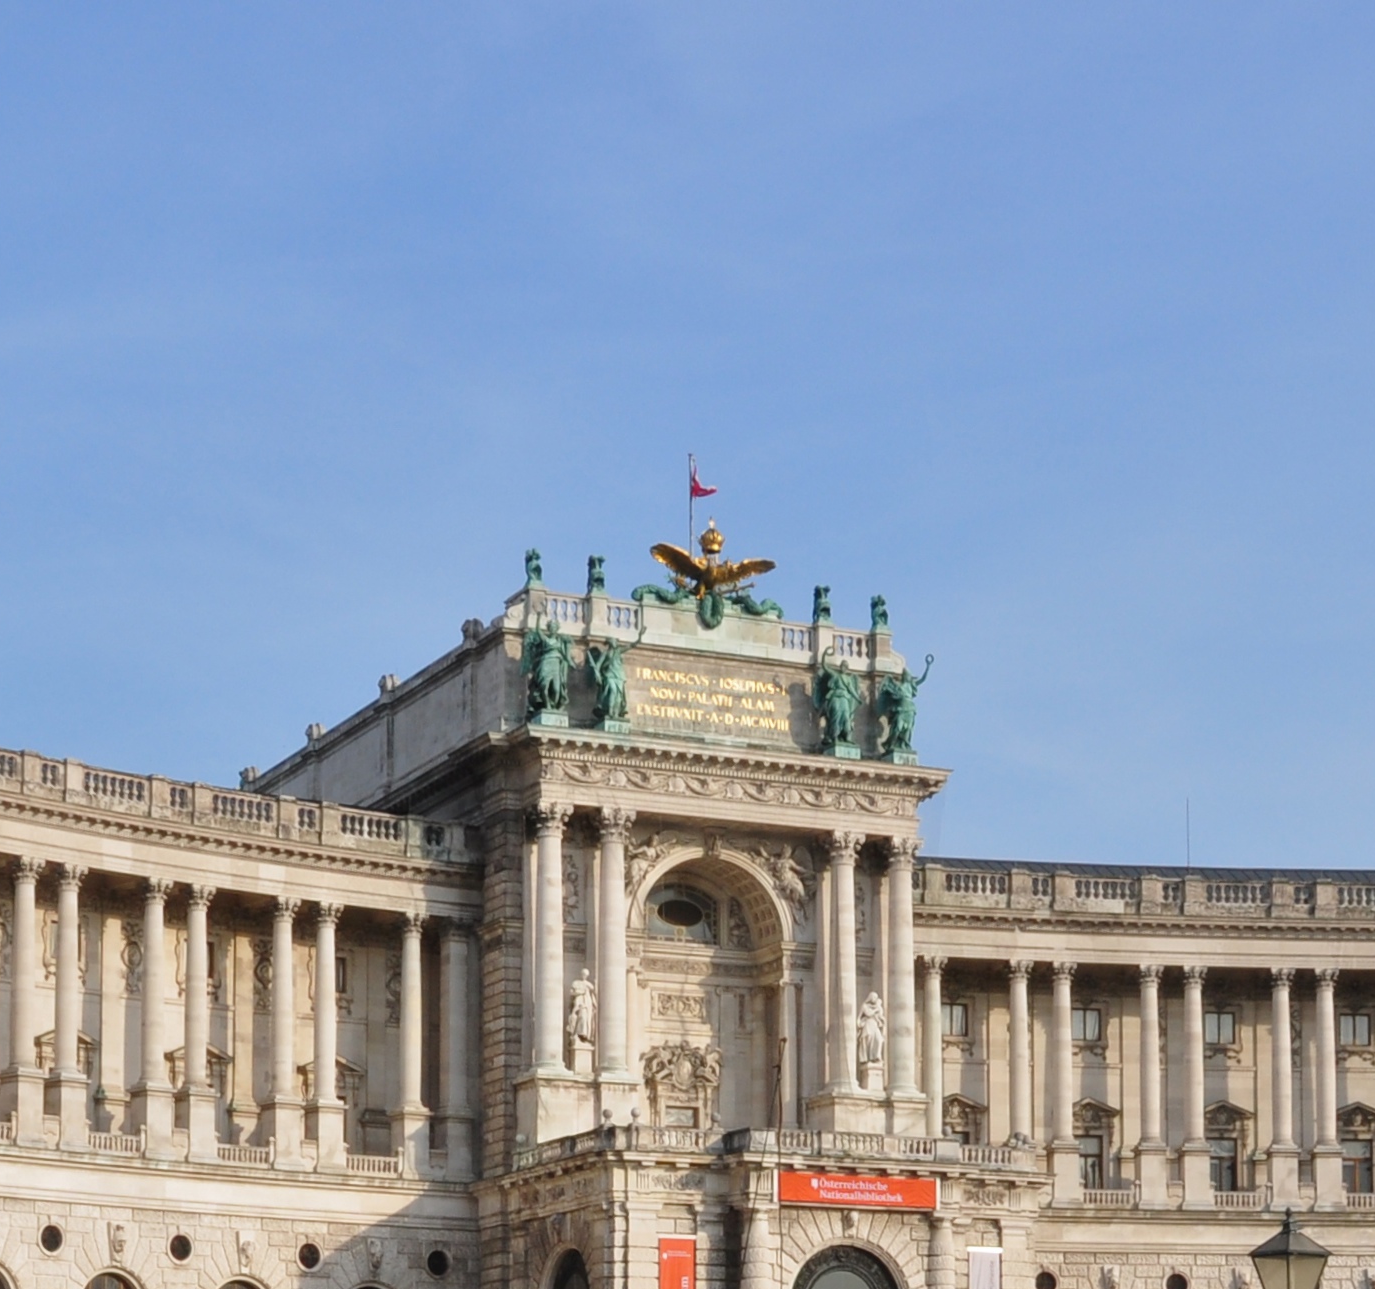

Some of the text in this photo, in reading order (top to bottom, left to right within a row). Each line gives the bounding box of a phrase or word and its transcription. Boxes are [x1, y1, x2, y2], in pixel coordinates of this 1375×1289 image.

[650, 687, 681, 701] NOVI
[740, 698, 776, 713] ALAM
[819, 1177, 889, 1191] Österreichische
[819, 1190, 903, 1202] Nationalbibliothek
